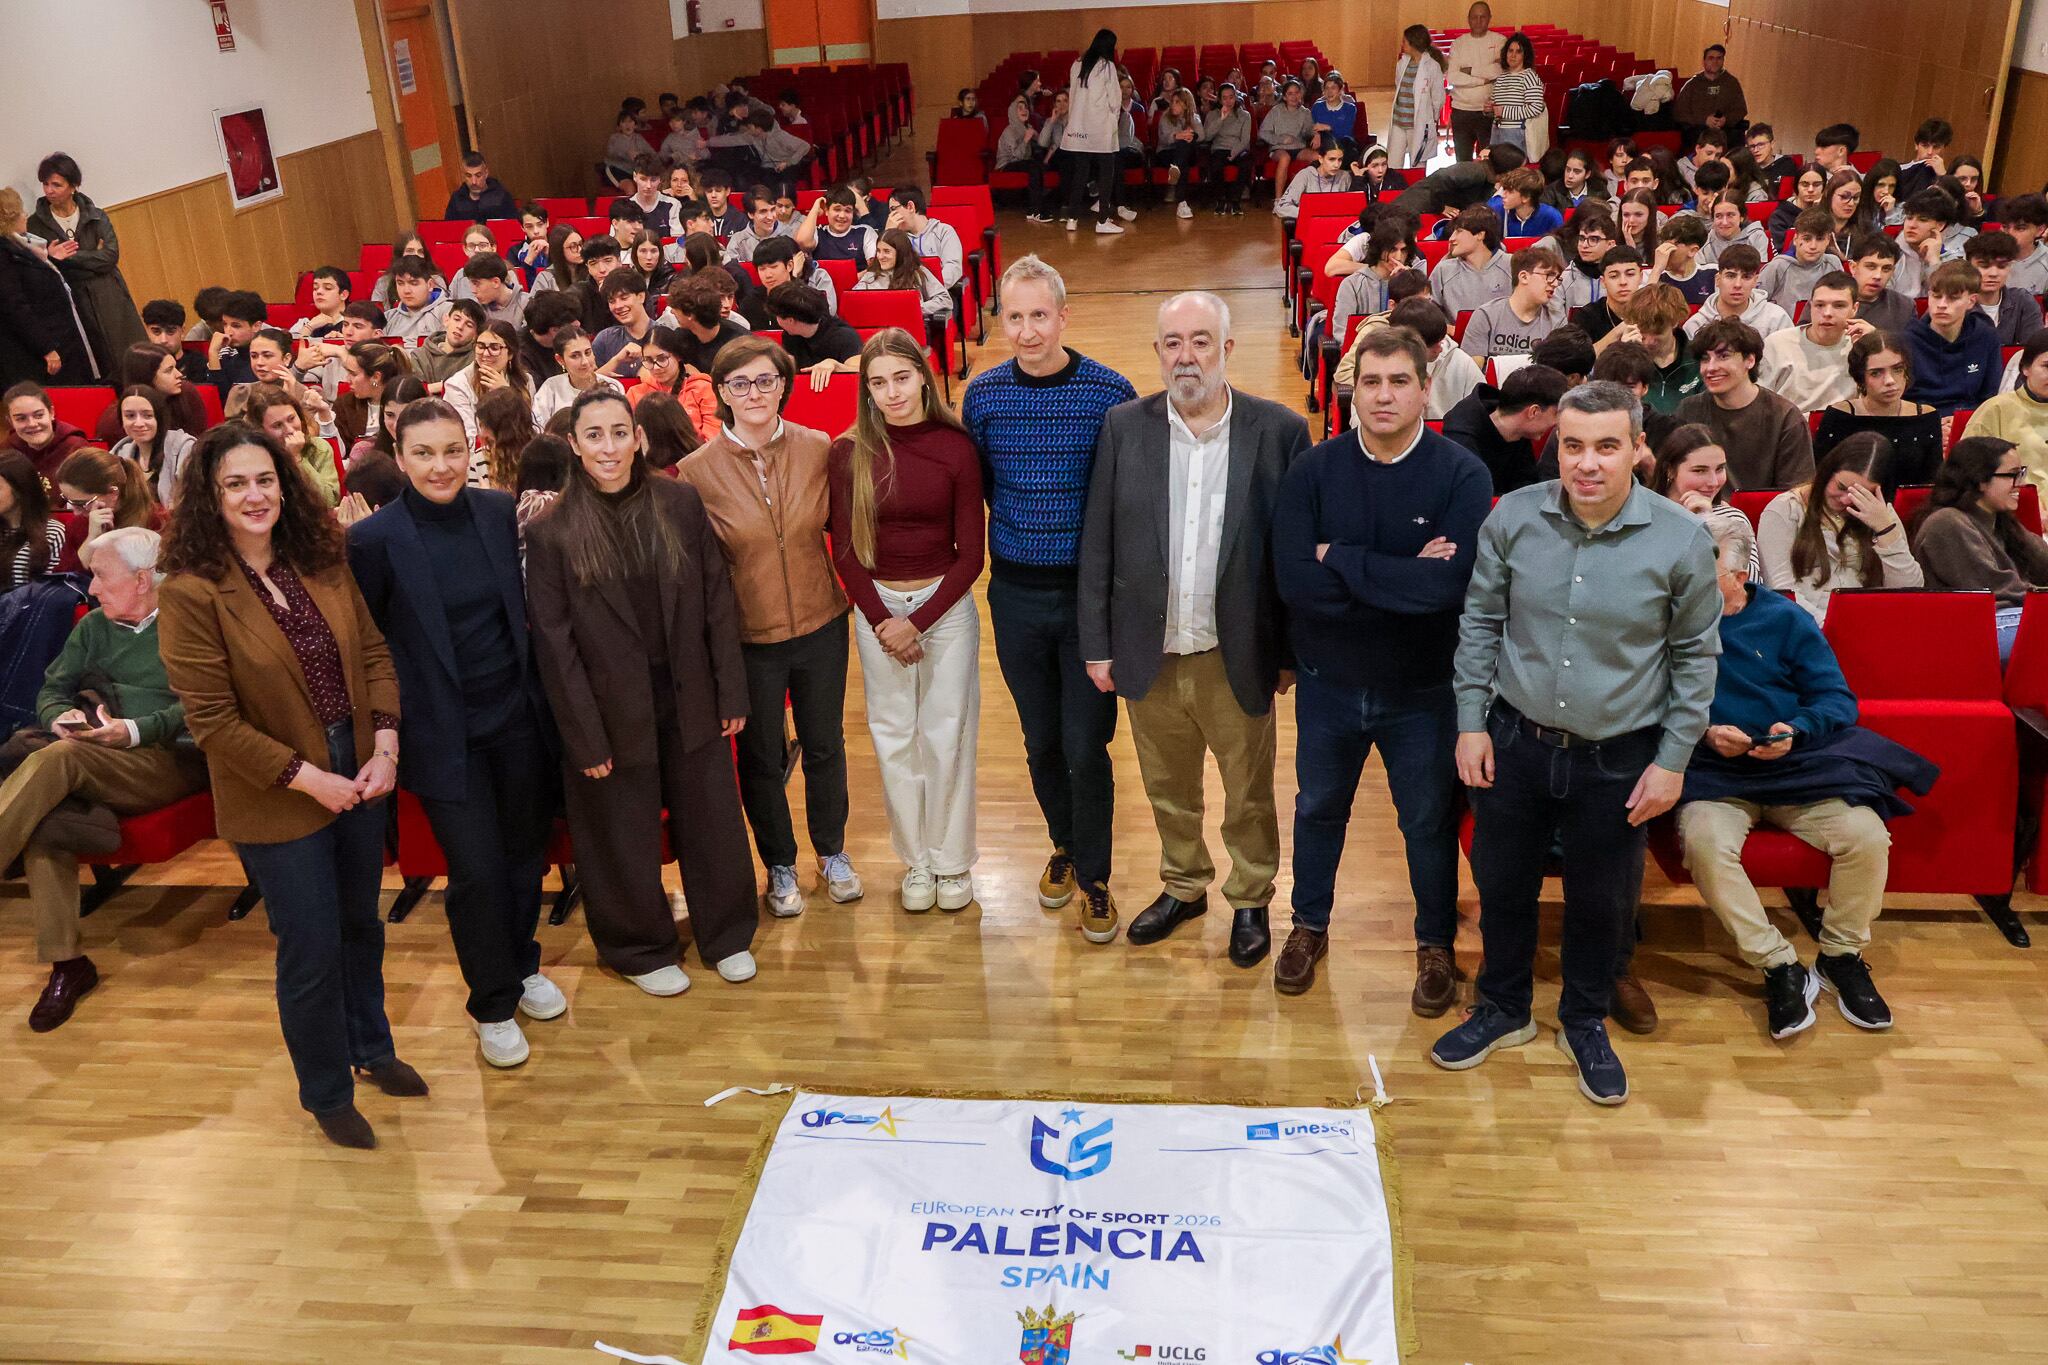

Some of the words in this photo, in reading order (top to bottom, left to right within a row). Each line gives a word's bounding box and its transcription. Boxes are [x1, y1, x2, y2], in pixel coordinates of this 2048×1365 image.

[1495, 334, 1531, 349] adid
[801, 1108, 881, 1128] aces
[1284, 1122, 1350, 1136] unesco
[911, 1200, 1014, 1218] EUROPEAN
[1020, 1204, 1065, 1219] CITY
[1068, 1208, 1097, 1221] OF
[1101, 1212, 1170, 1225] SPORT
[1173, 1214, 1221, 1226] 2026
[922, 1221, 1205, 1263] PALENCIA
[1000, 1262, 1110, 1291] SPAIN
[833, 1329, 894, 1347] aces
[1158, 1345, 1206, 1361] UCLG
